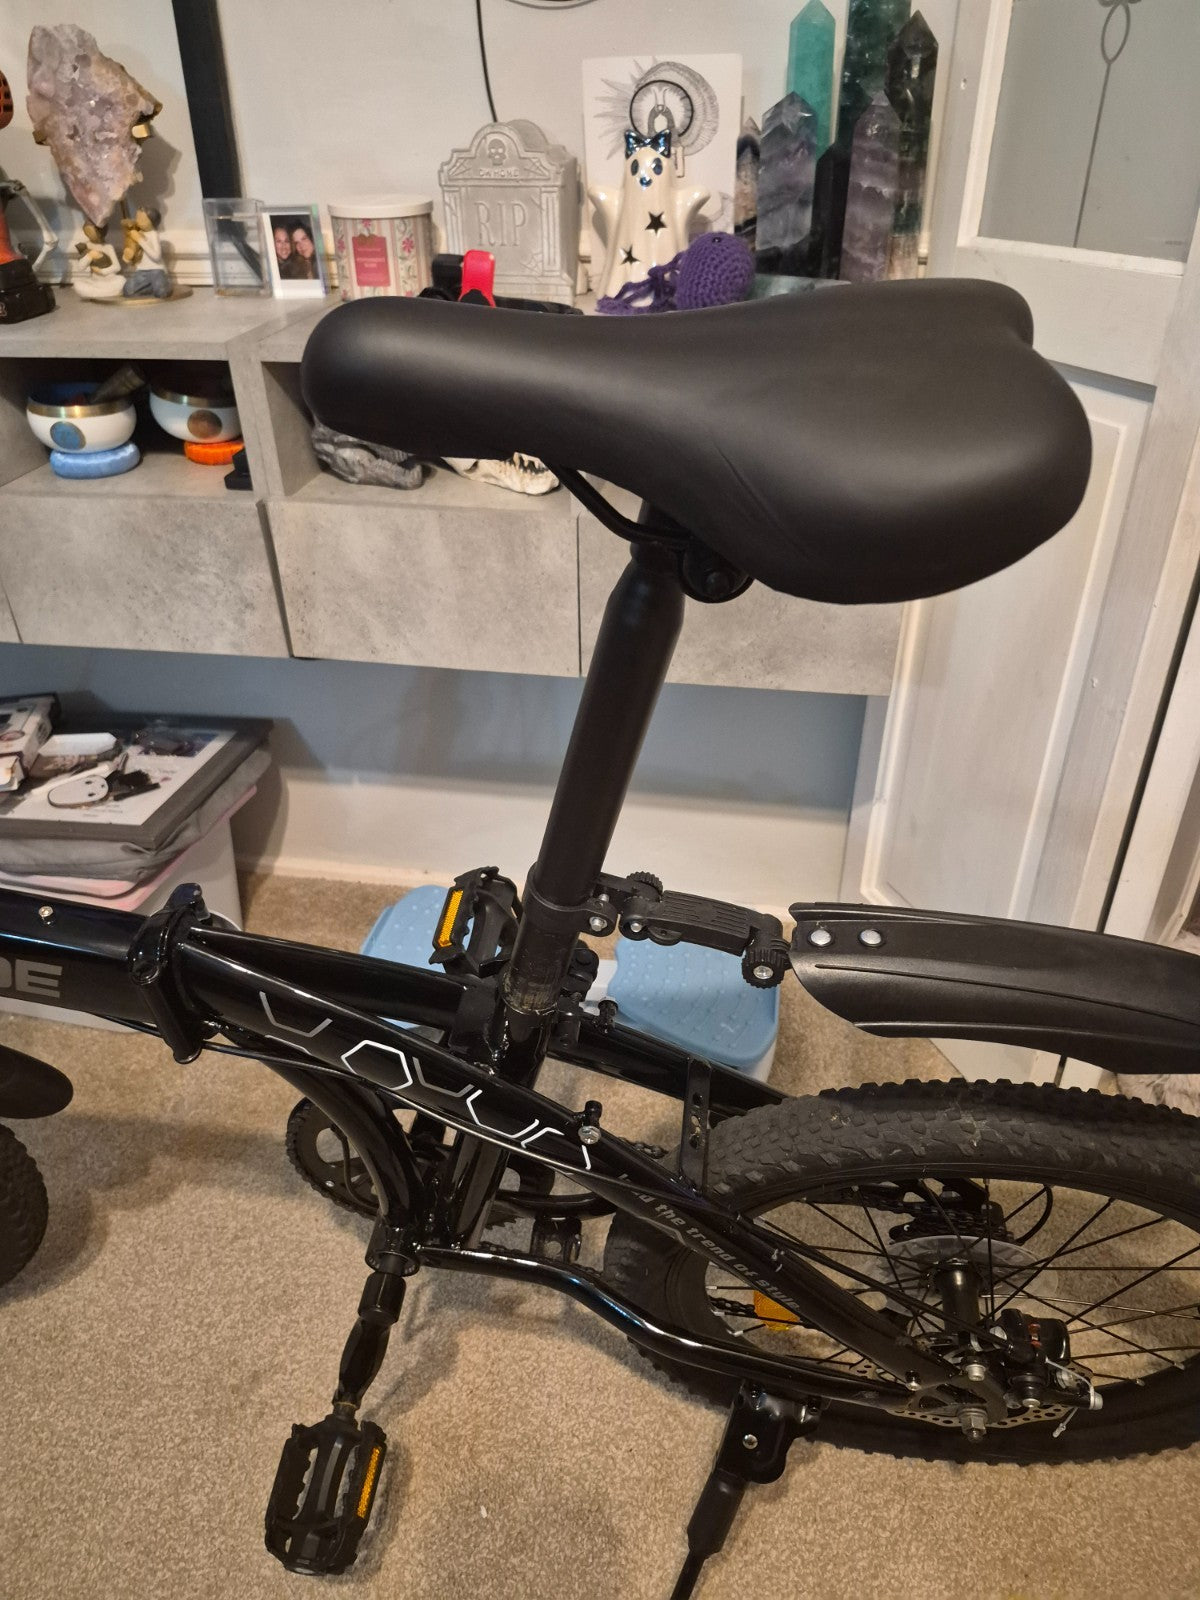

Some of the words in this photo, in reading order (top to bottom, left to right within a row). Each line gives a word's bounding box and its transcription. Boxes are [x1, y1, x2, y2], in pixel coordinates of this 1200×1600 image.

[474, 200, 527, 247] RIP
[655, 1204, 686, 1225] the
[686, 1227, 735, 1261] trend
[734, 1263, 759, 1277] of
